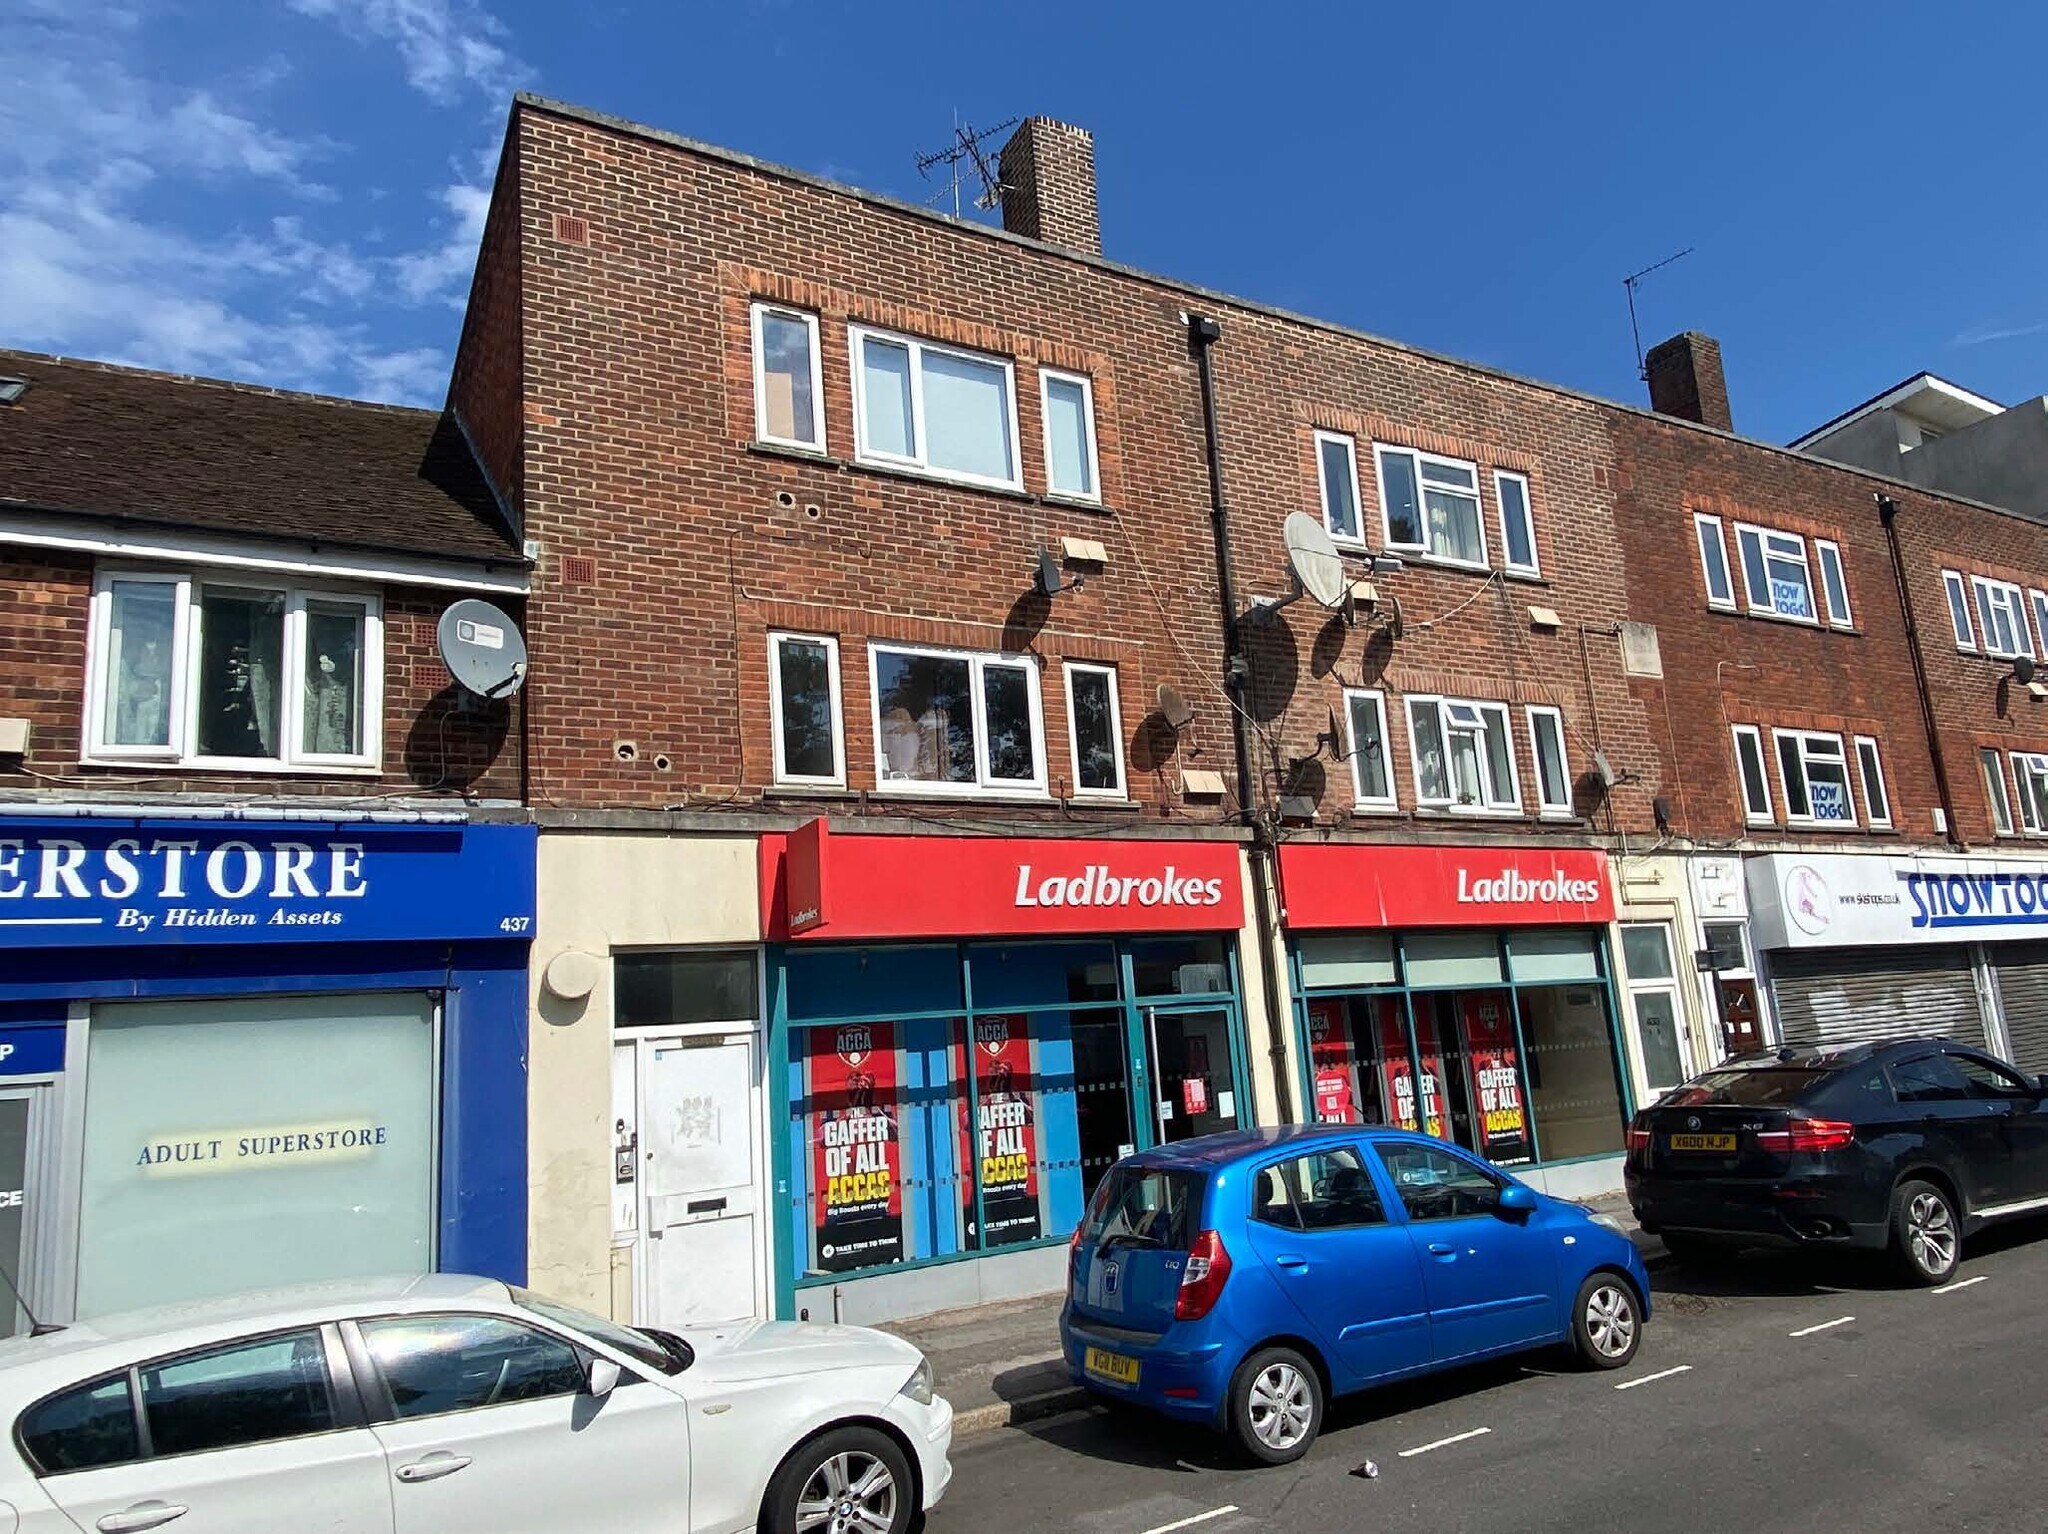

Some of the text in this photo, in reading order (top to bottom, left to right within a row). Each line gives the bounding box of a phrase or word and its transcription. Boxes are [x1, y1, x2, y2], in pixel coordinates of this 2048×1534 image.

[0, 839, 367, 899] ERSTORE
[1014, 865, 1222, 907] Ladbrokes
[1457, 869, 1600, 903] Ladbrokes
[115, 908, 343, 931] By Hidden Assets
[500, 916, 530, 931] 437
[836, 1032, 872, 1052] ACCA
[978, 1022, 1009, 1041] ACCA
[1478, 1068, 1516, 1089] GAFFER
[1398, 1096, 1415, 1120] OF
[1481, 1086, 1519, 1111] OF ALL
[979, 1102, 1025, 1130] AFFER
[1486, 1109, 1522, 1131] ACCAS
[824, 1115, 889, 1147] GAFFER
[996, 1126, 1027, 1156] ALL
[1674, 1136, 1730, 1148] X600 NJP
[136, 1127, 387, 1165] ADULT SUPERSTORE
[825, 1141, 890, 1177] OF ALL
[982, 1153, 1028, 1185] CCAS
[827, 1170, 891, 1205] ACCAS
